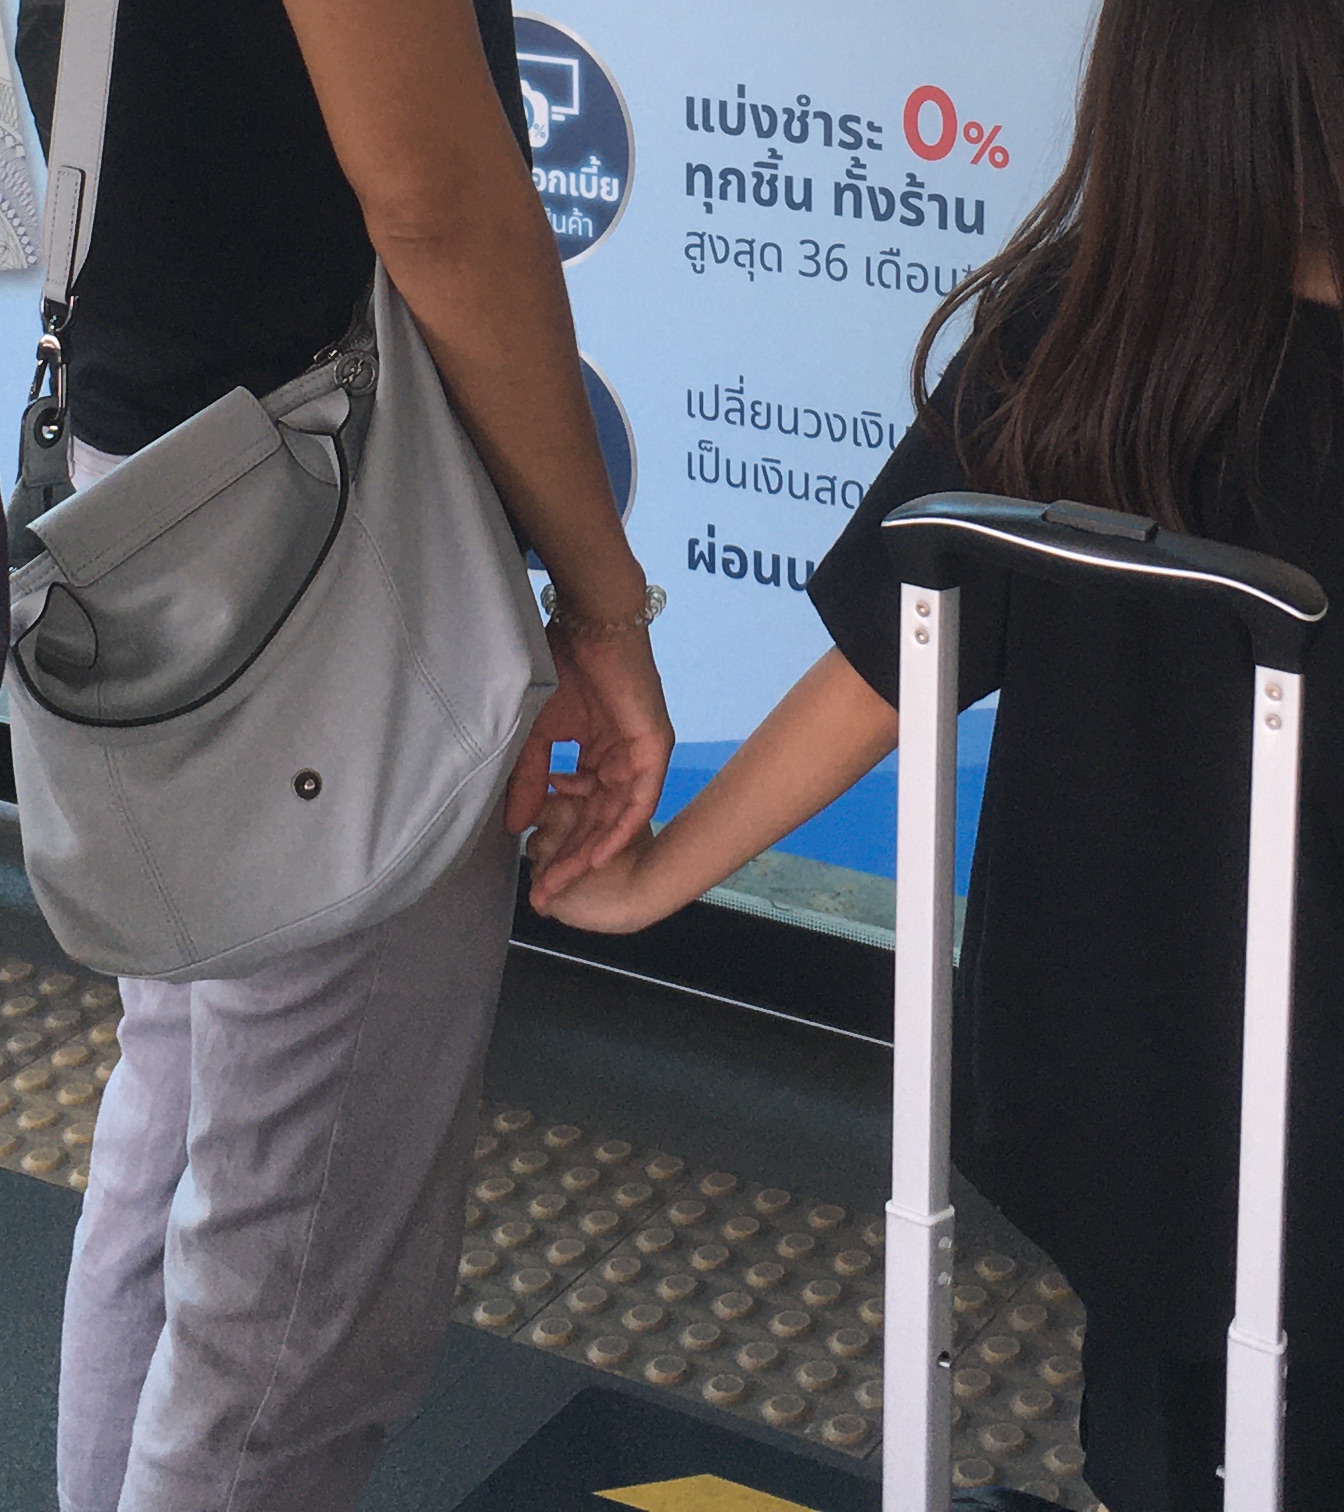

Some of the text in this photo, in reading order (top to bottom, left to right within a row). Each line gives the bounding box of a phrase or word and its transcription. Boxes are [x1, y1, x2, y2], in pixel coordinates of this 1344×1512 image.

[684, 83, 1011, 171] แบ่งชำระ 0%
[532, 155, 620, 203] อกเบี้ย
[684, 145, 987, 237] ทุกชิ้น ทั้งร้าน
[683, 229, 783, 276] สูงสุด
[797, 238, 849, 282] 36
[687, 439, 864, 510] เป็นเงินสด
